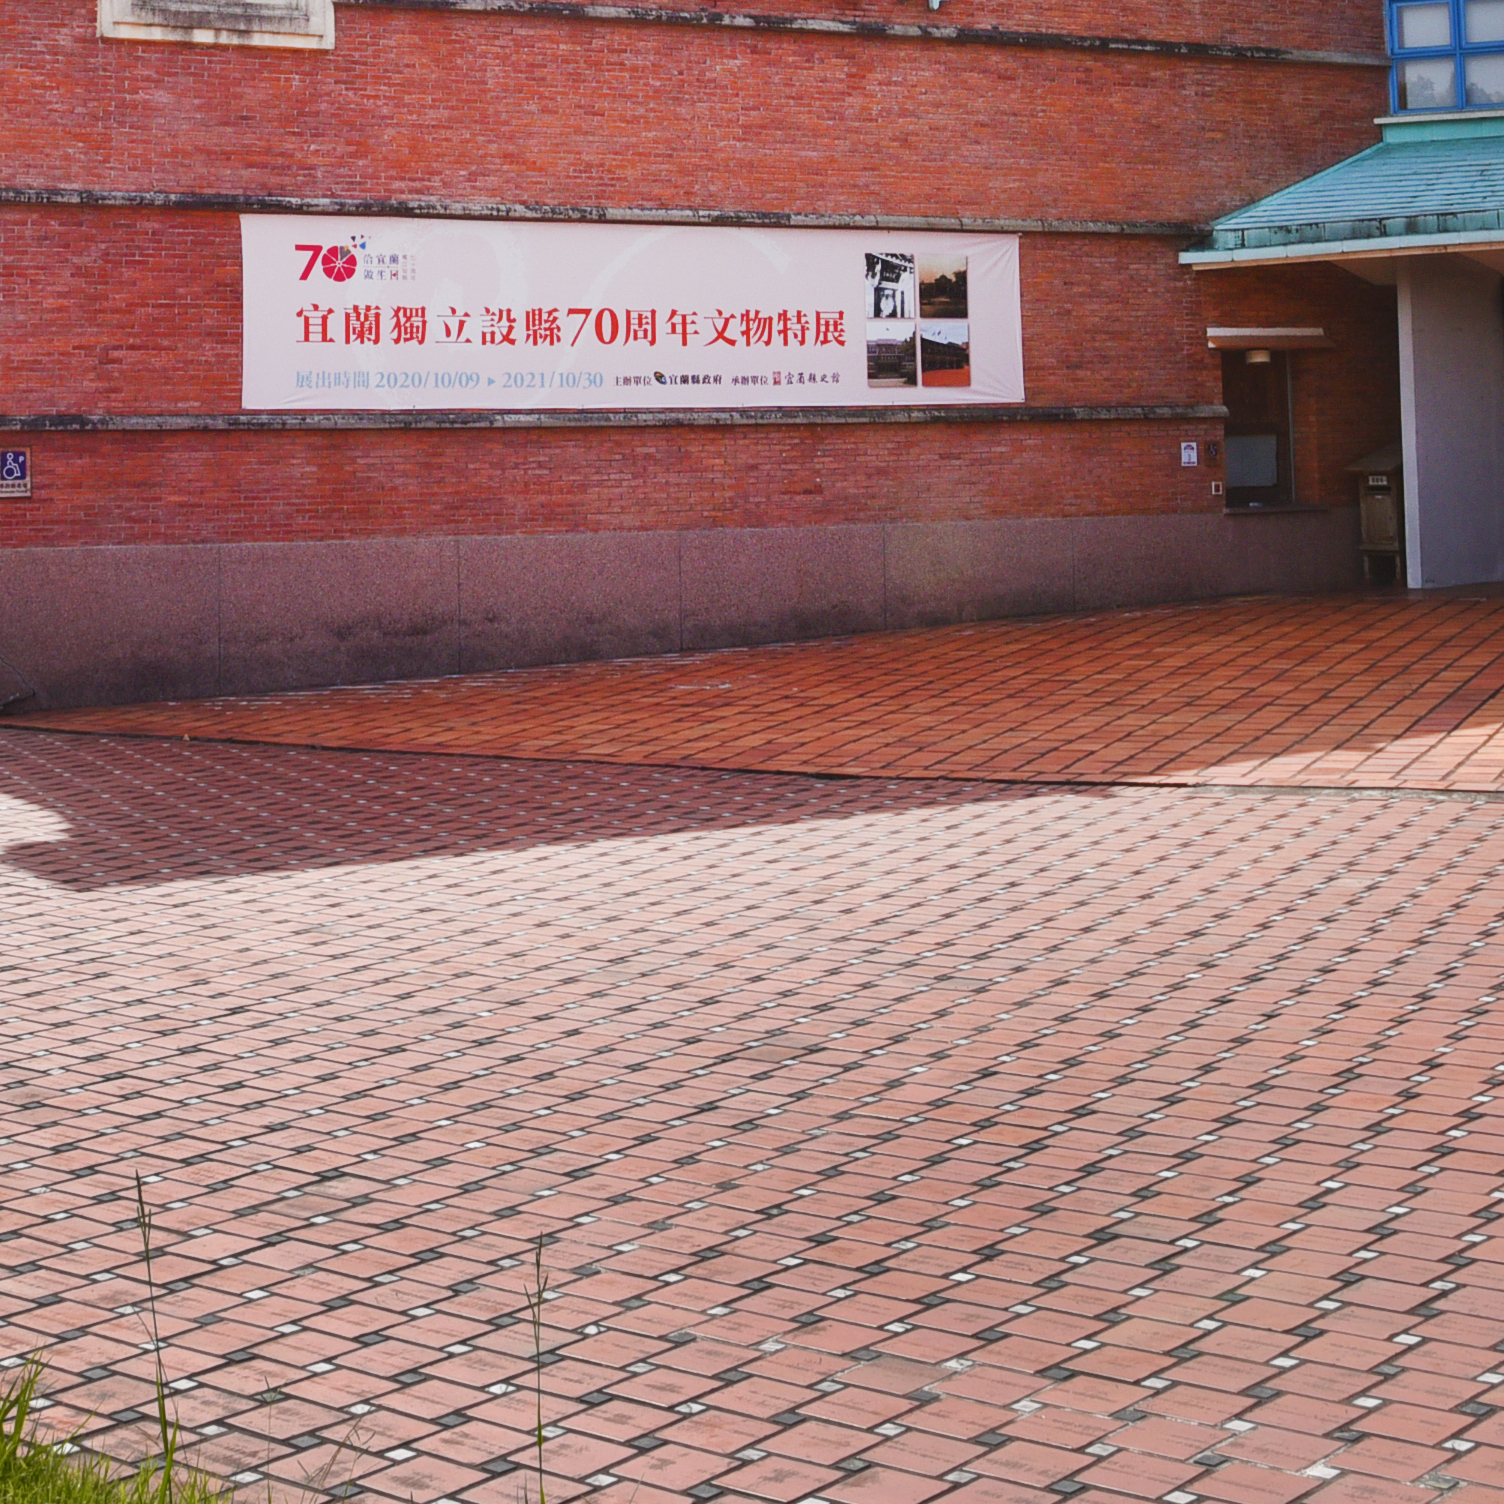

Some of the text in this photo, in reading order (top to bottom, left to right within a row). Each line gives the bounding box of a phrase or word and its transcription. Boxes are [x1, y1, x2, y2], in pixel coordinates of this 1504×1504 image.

[295, 302, 847, 347] 宜蘭獨立設縣70周年文物特展
[295, 370, 604, 390] 展出時間 2020/10/09 2021/10/30
[613, 375, 652, 387] 主辦單位
[668, 373, 723, 386] 宜蘭縣政府
